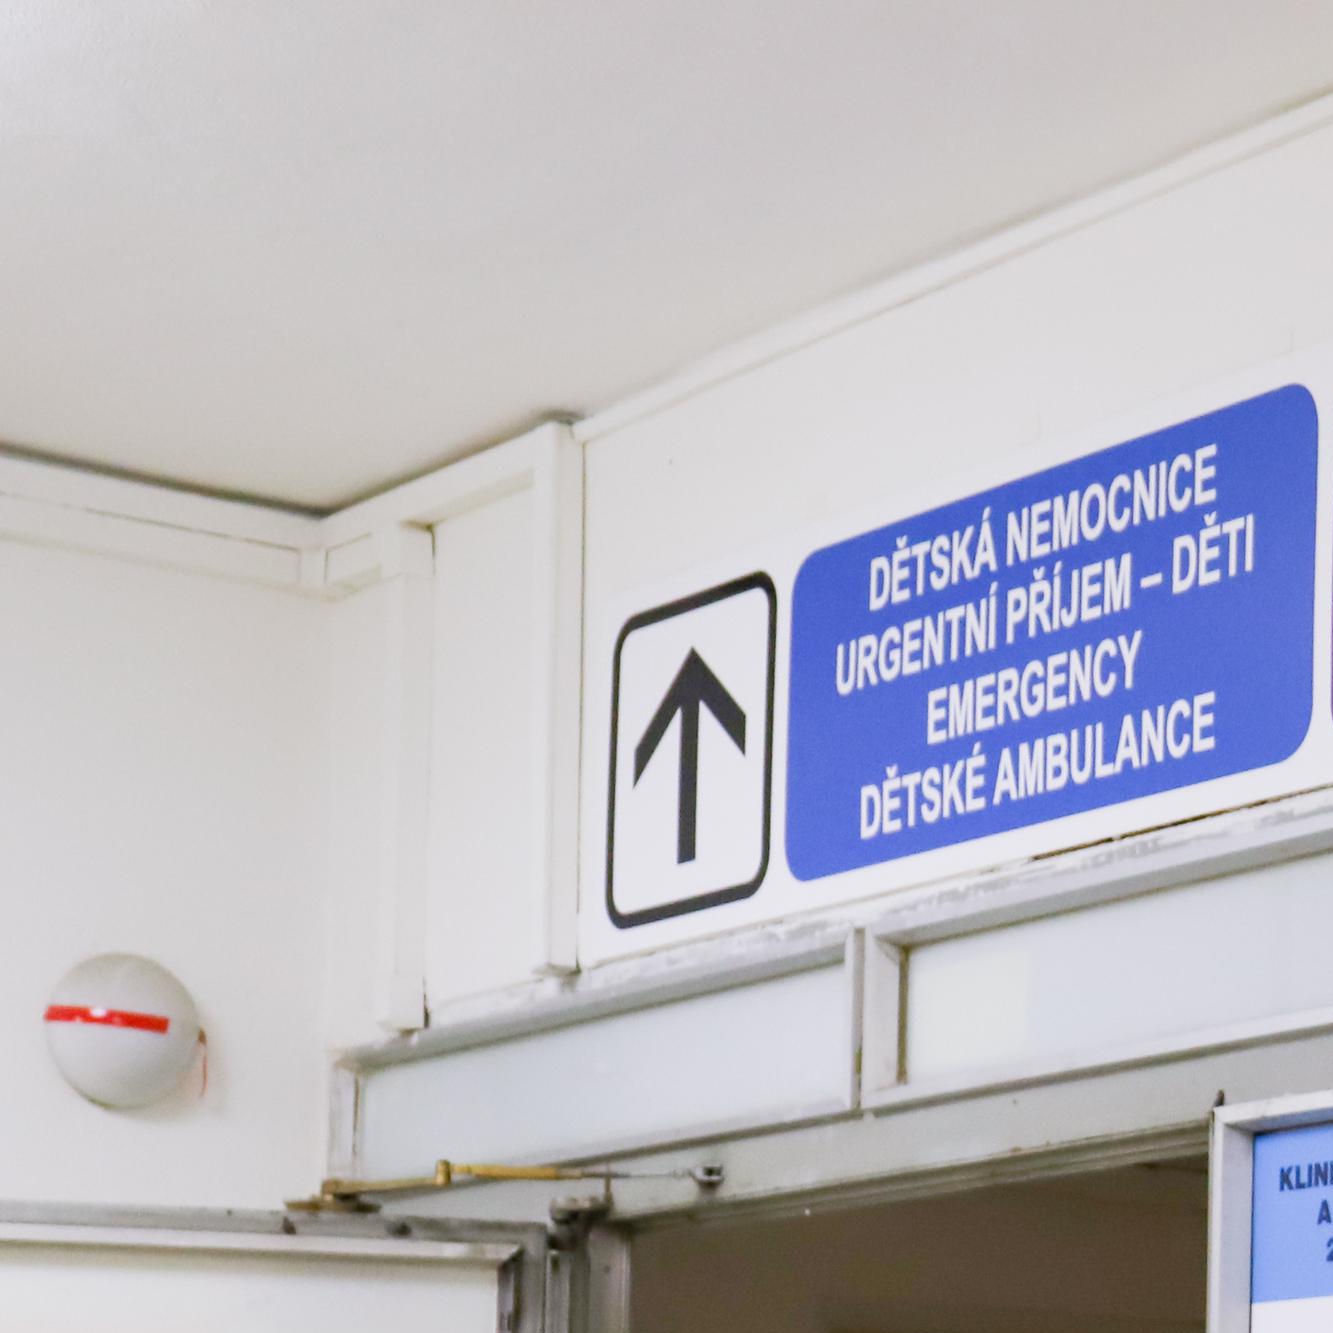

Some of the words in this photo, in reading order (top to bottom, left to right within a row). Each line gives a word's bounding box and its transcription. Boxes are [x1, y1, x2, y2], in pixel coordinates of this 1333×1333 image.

[868, 507, 997, 611] DĚTSKÁ
[1006, 444, 1218, 563] NEMOCNICE
[836, 582, 999, 696] URGENTNÍ
[1006, 553, 1132, 644] PŘÍJEM
[1172, 513, 1255, 594] DĚTI
[927, 630, 1143, 745] EMERGENCY
[860, 745, 985, 840] DĚTSKÉ
[993, 690, 1216, 806] AMBULANCE
[1317, 1197, 1333, 1225] A
